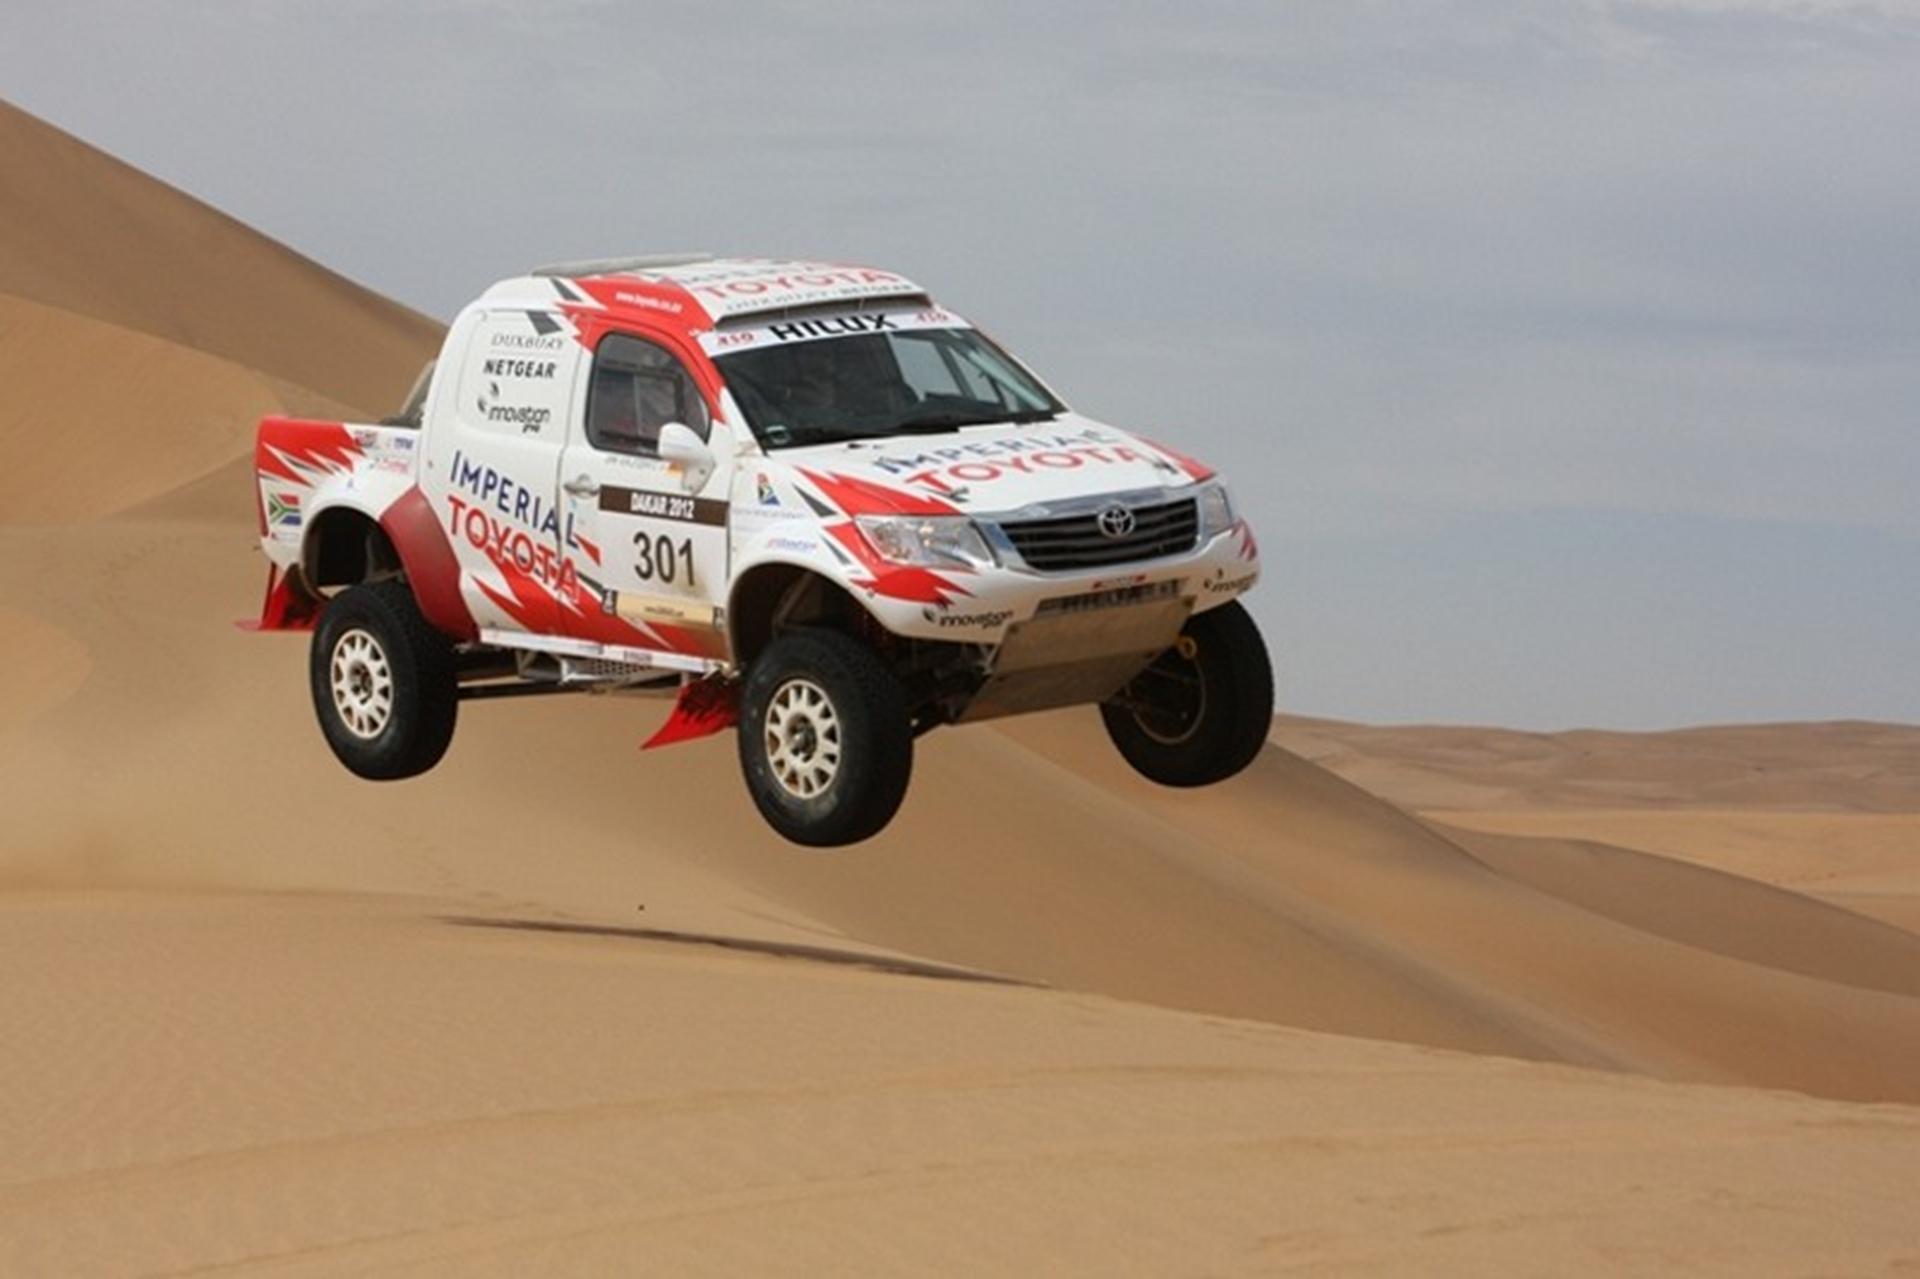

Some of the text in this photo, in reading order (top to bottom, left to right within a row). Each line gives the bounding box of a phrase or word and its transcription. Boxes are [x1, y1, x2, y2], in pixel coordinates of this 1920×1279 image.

[698, 269, 899, 299] TOYOTA
[491, 333, 564, 350] DUXBURY
[769, 313, 898, 341] HILUX
[483, 359, 556, 379] NETGEAR
[488, 405, 551, 424] innovation
[873, 429, 1119, 474] IMPERIAL
[904, 444, 1142, 494] TOYOTA
[450, 449, 579, 550] IMPERIAL
[631, 491, 694, 519] DAKAR 2012
[447, 493, 580, 605] TOYOTA
[633, 531, 695, 587] 301
